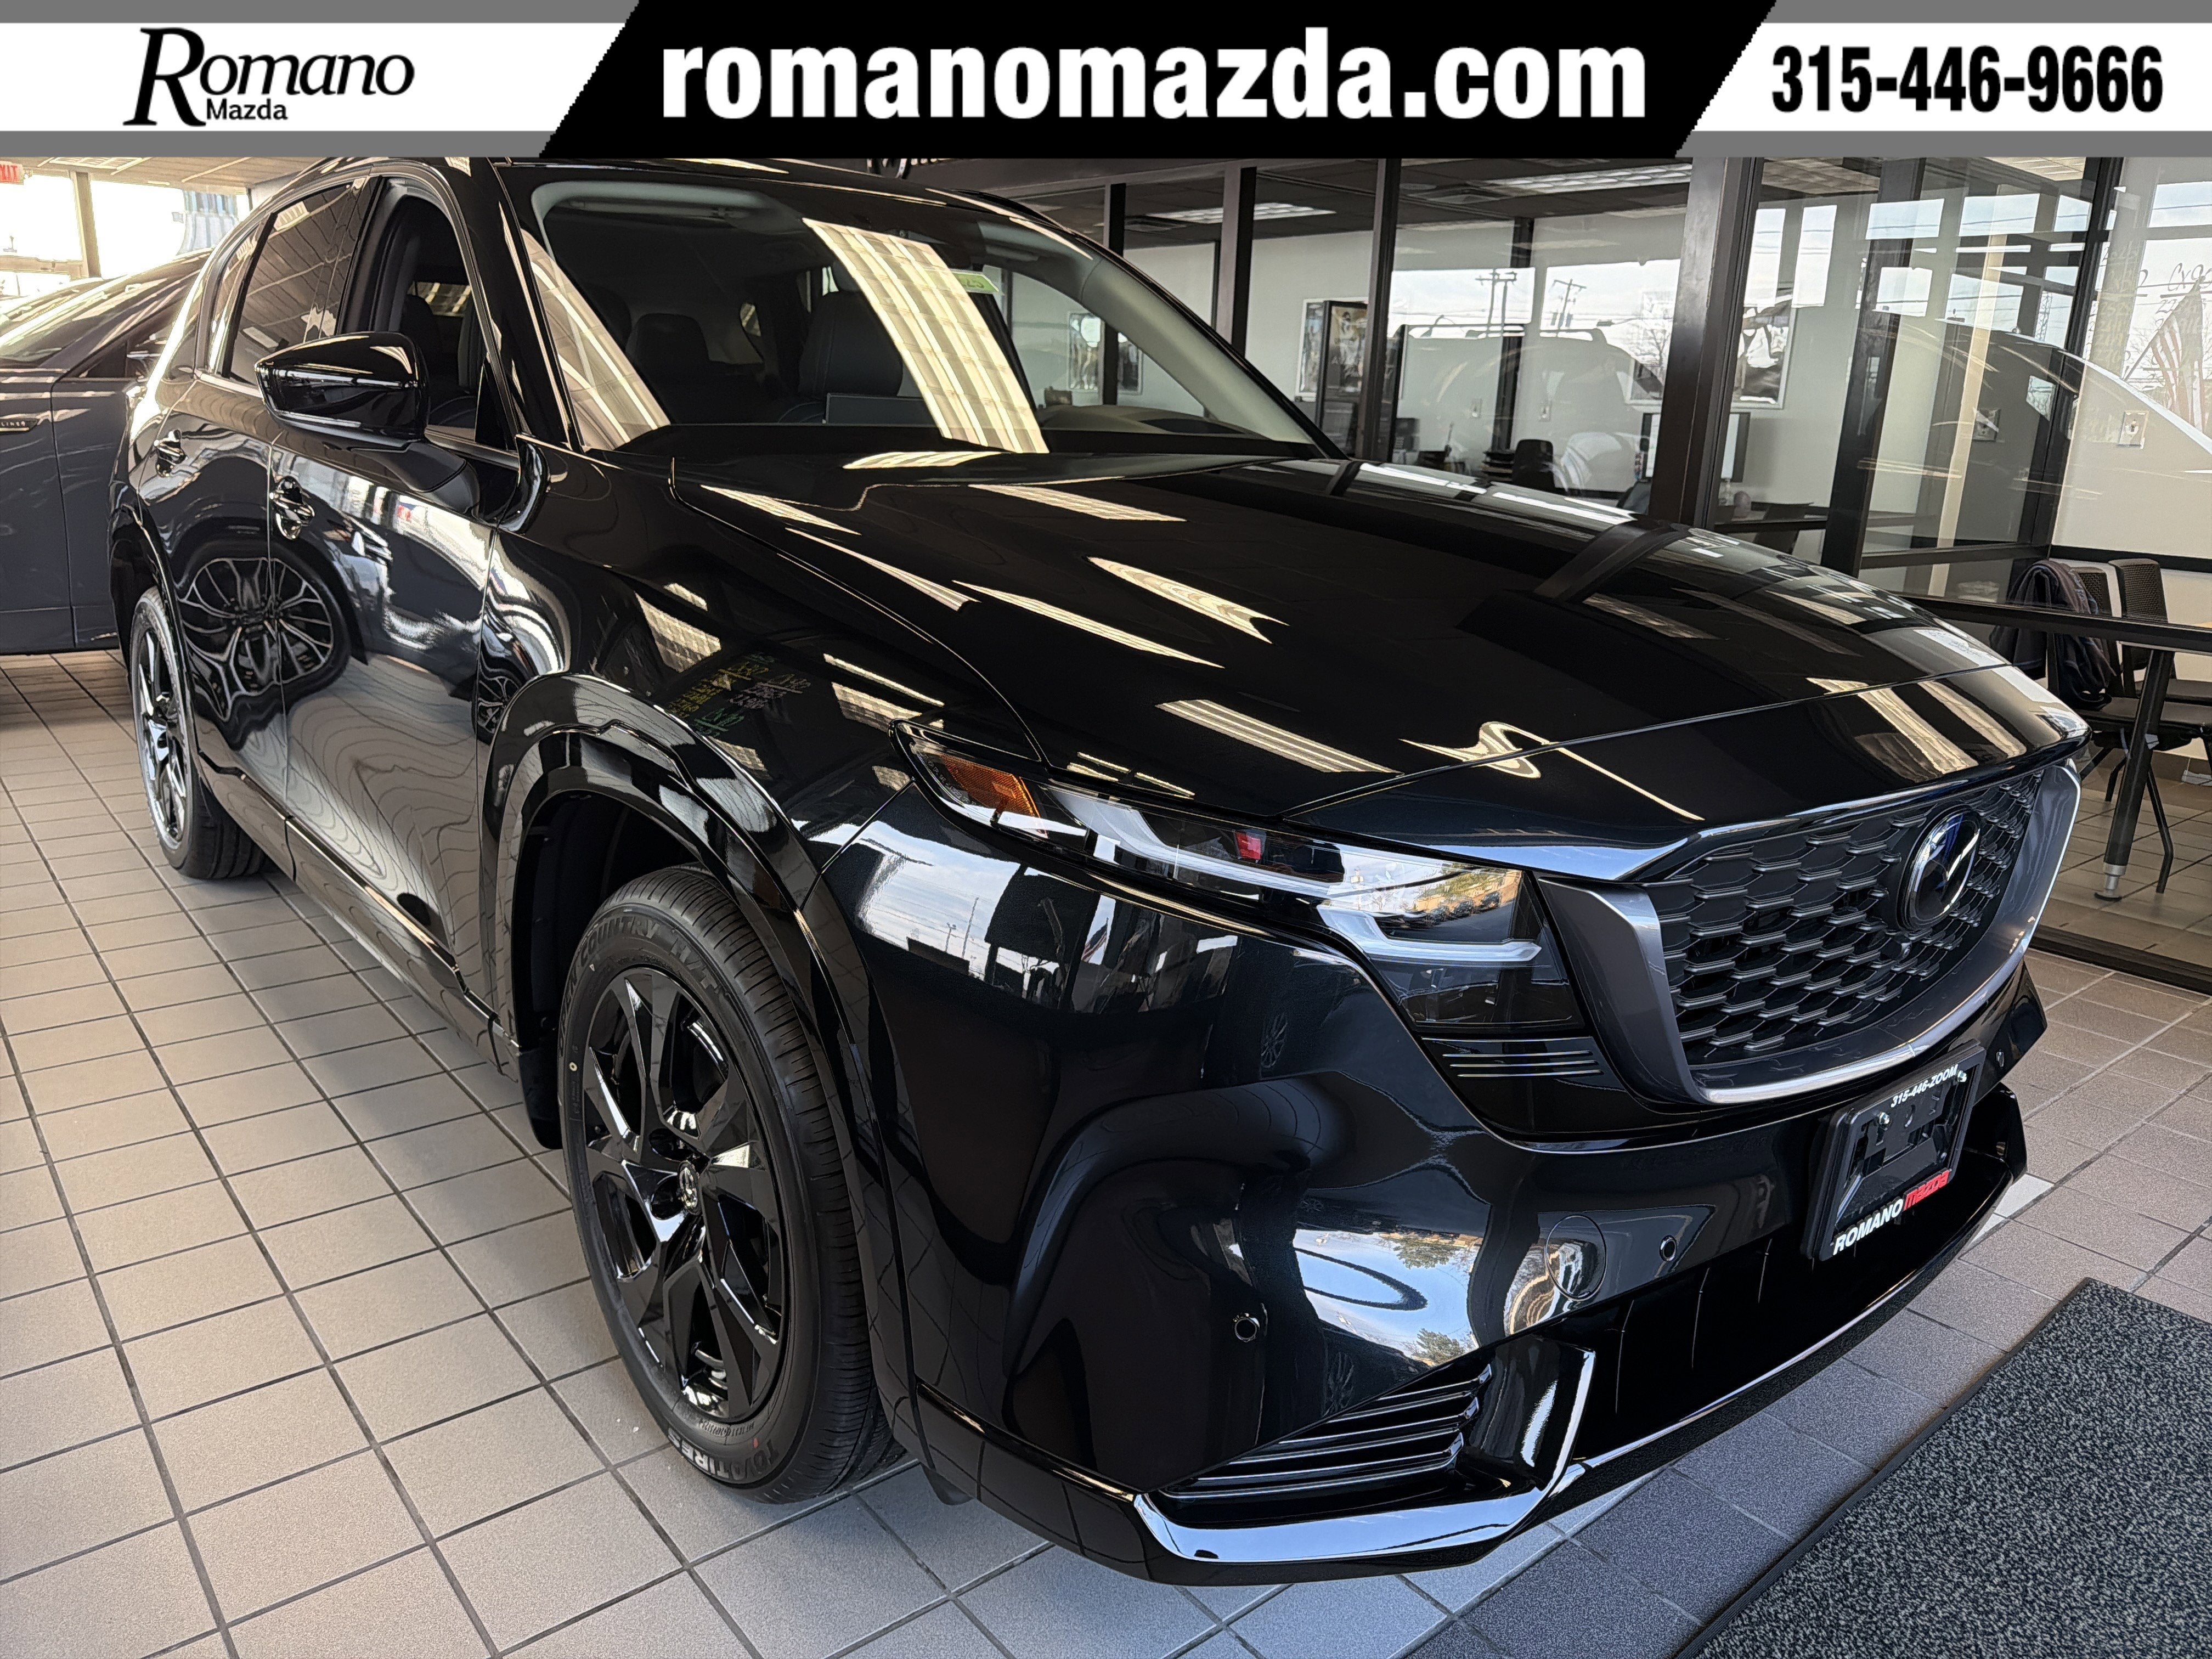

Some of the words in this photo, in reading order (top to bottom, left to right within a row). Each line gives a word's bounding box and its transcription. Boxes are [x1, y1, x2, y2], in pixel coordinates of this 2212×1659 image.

[0, 164, 18, 182] XIT
[580, 916, 659, 967] COUNTRY
[1891, 1064, 1959, 1108] 315-446-ZOOM
[1833, 1198, 1904, 1255] ROMANO
[668, 1427, 730, 1479] TIRES
